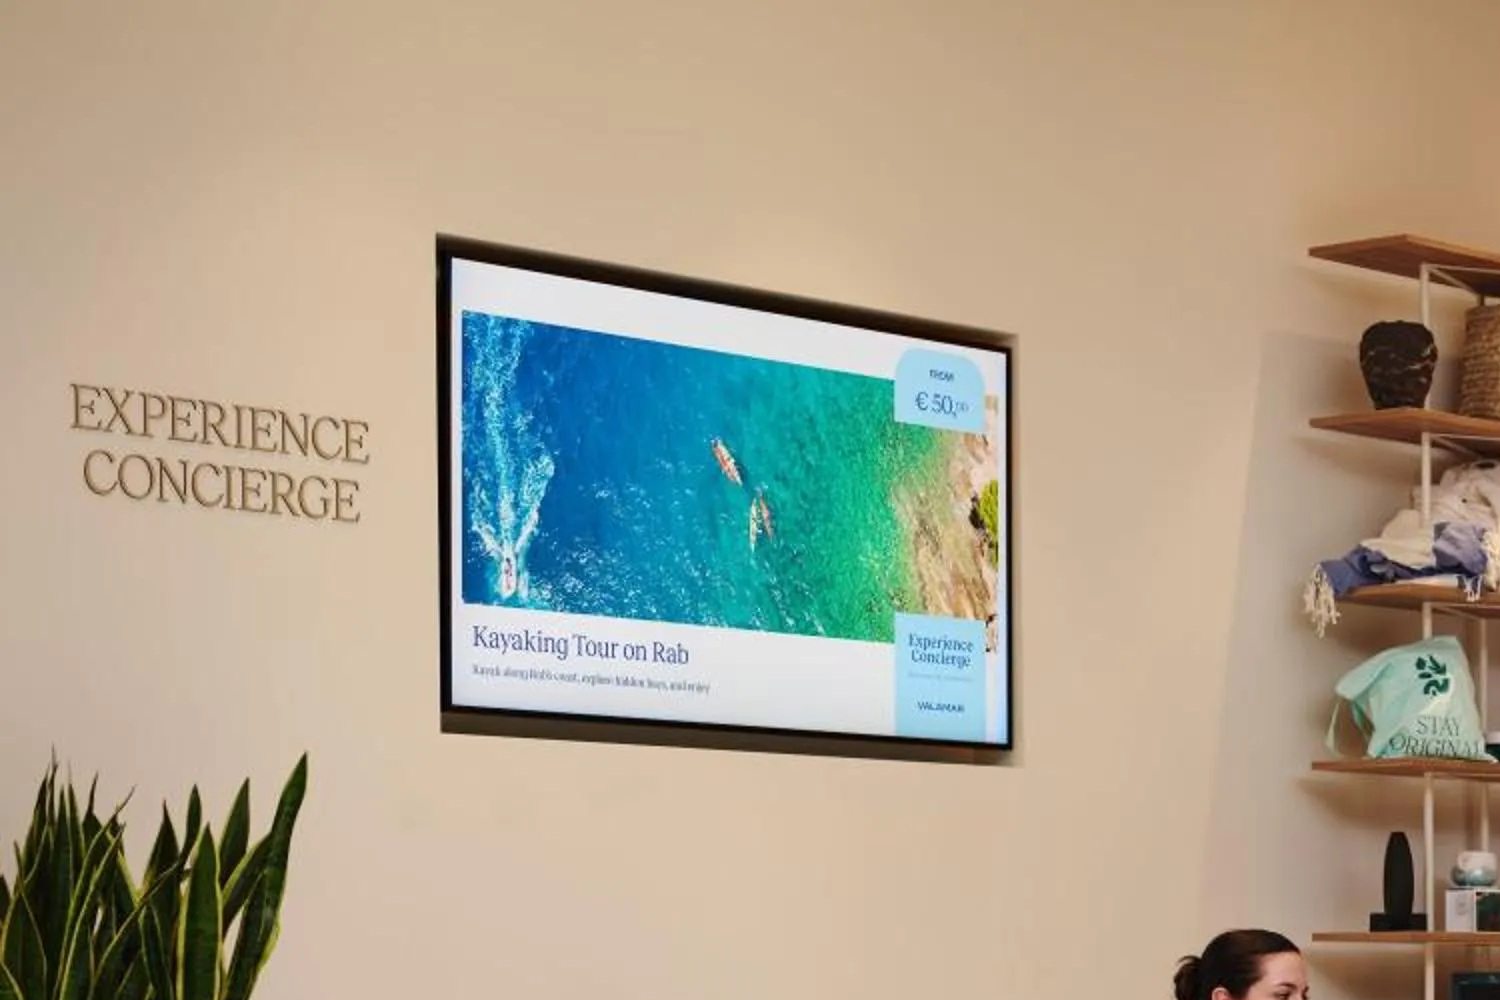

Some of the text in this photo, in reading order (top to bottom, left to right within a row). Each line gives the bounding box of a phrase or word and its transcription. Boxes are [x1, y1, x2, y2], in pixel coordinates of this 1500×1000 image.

[70, 383, 370, 465] EXPERIENCE
[83, 448, 361, 523] CONCIERGE
[472, 625, 689, 665] Kayaking Tour on Rab
[909, 633, 974, 652] Experience
[911, 649, 971, 669] Concierge
[1416, 715, 1459, 737] STAY
